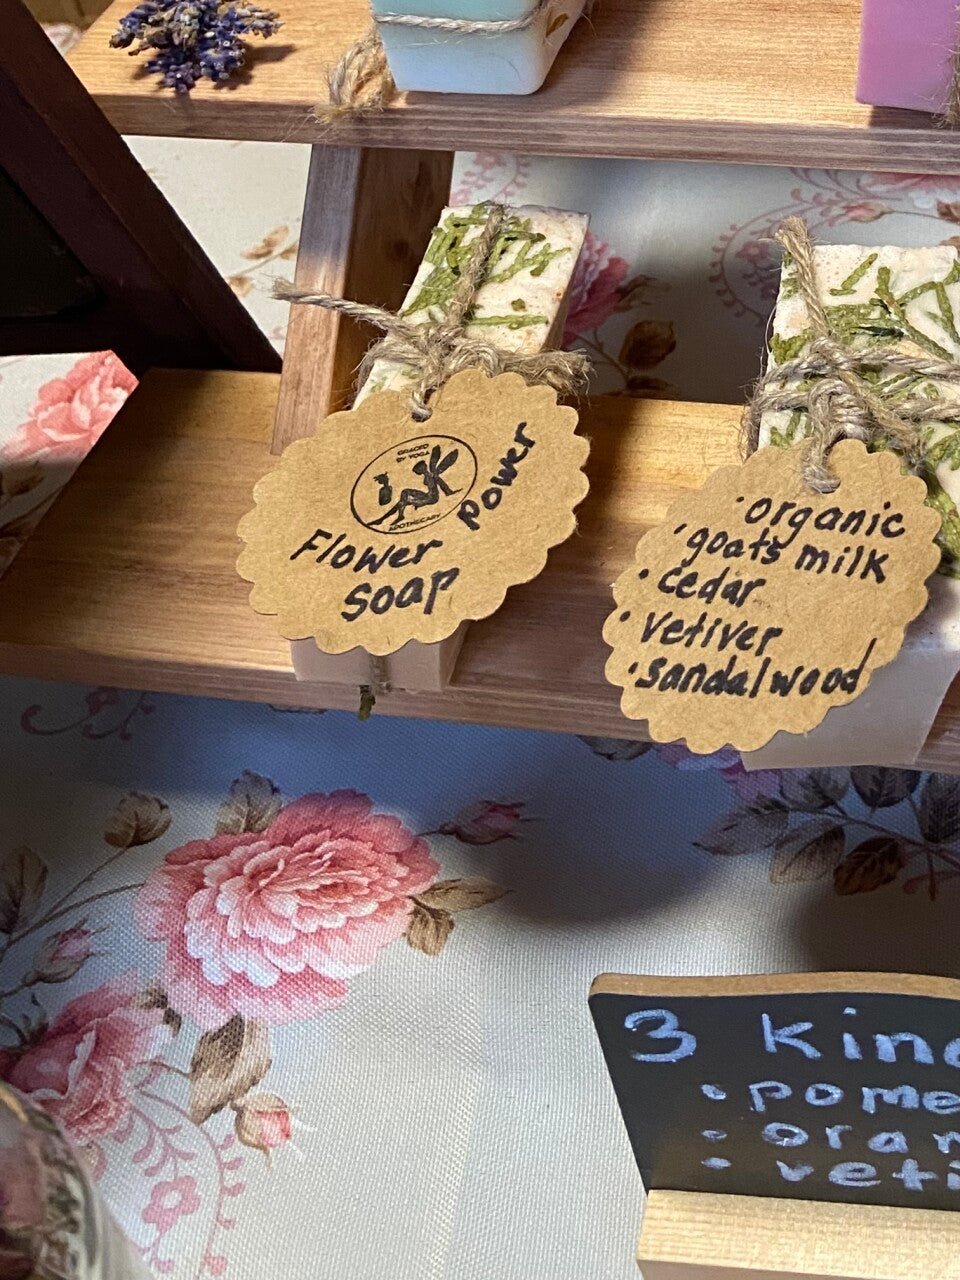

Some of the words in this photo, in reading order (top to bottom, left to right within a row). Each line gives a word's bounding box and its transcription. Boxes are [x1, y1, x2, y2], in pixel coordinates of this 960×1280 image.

[396, 443, 429, 456] GRACED
[795, 544, 890, 584] milk
[624, 1008, 698, 1063] 3
